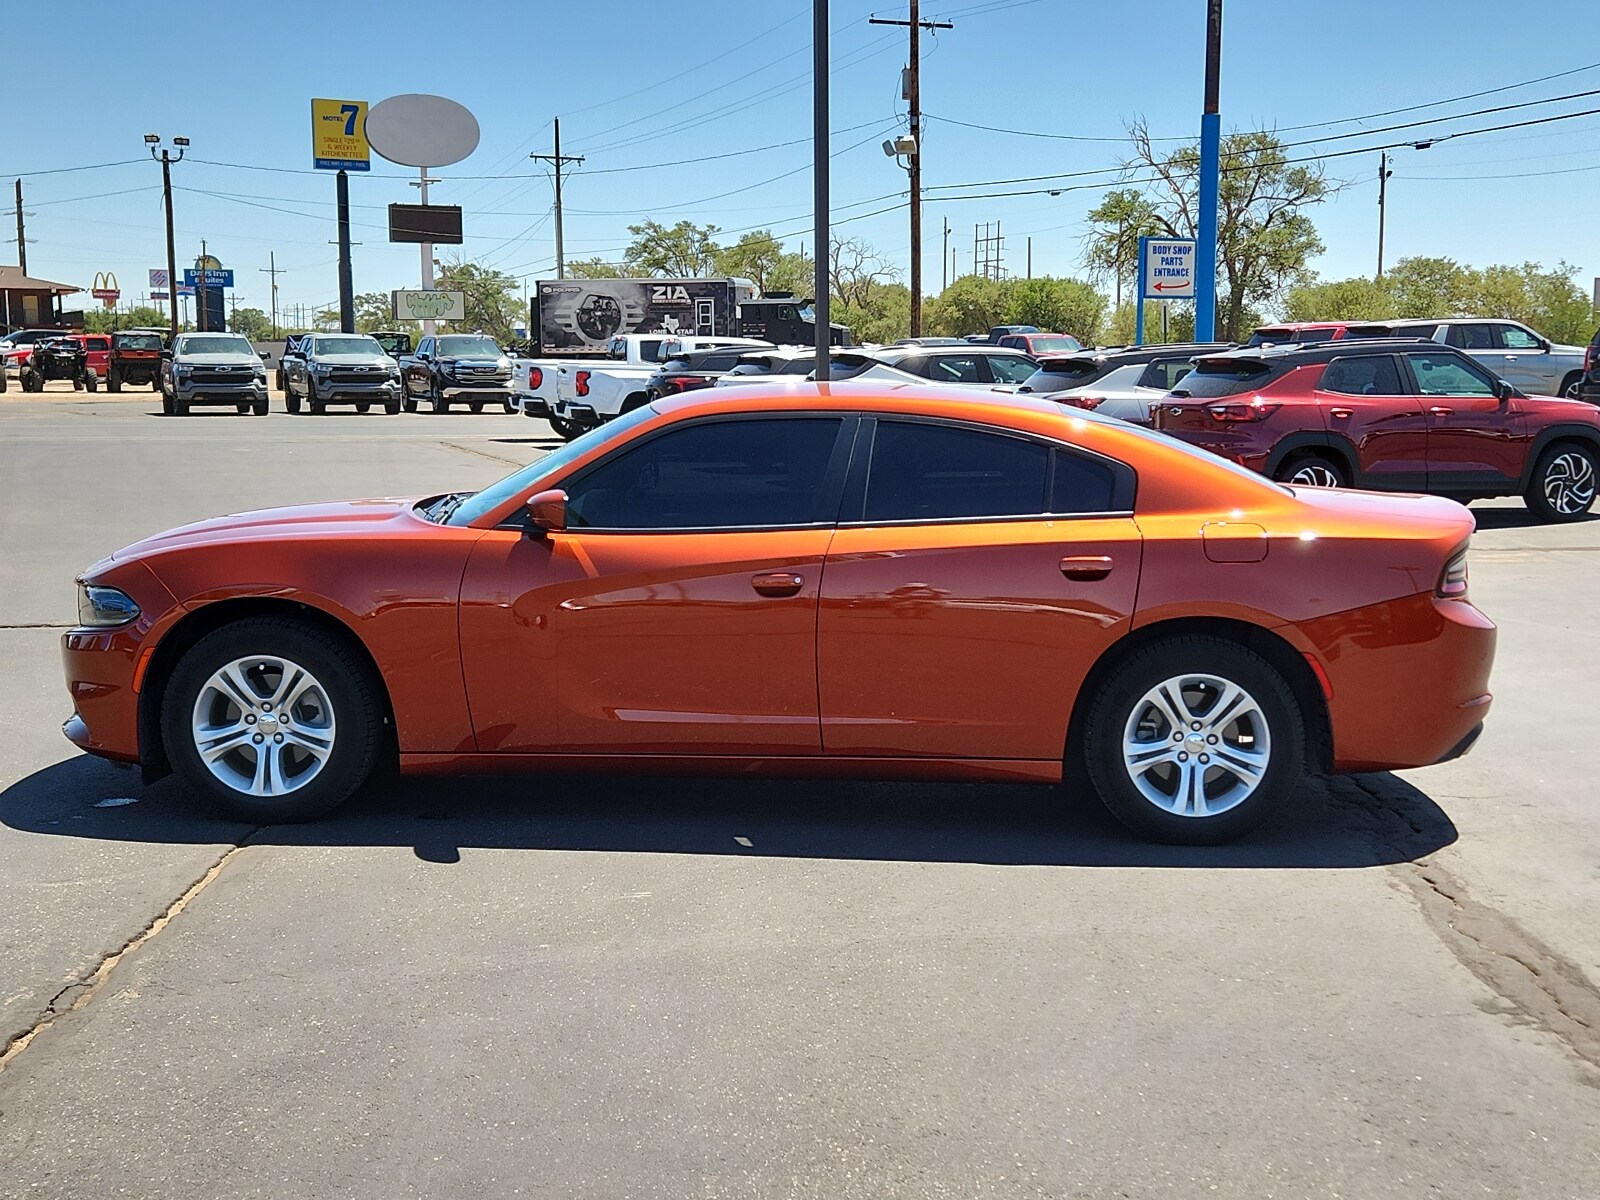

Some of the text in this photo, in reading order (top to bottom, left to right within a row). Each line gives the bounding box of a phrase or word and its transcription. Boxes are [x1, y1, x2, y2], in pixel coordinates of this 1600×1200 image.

[340, 104, 359, 135] 7
[321, 150, 363, 158] KITCHENETTES
[1152, 245, 1192, 255] BODY SHOP
[1161, 256, 1183, 266] PARTS
[213, 270, 228, 278] Inn
[1154, 267, 1189, 277] ENTRANCE
[651, 285, 690, 300] ZIA
